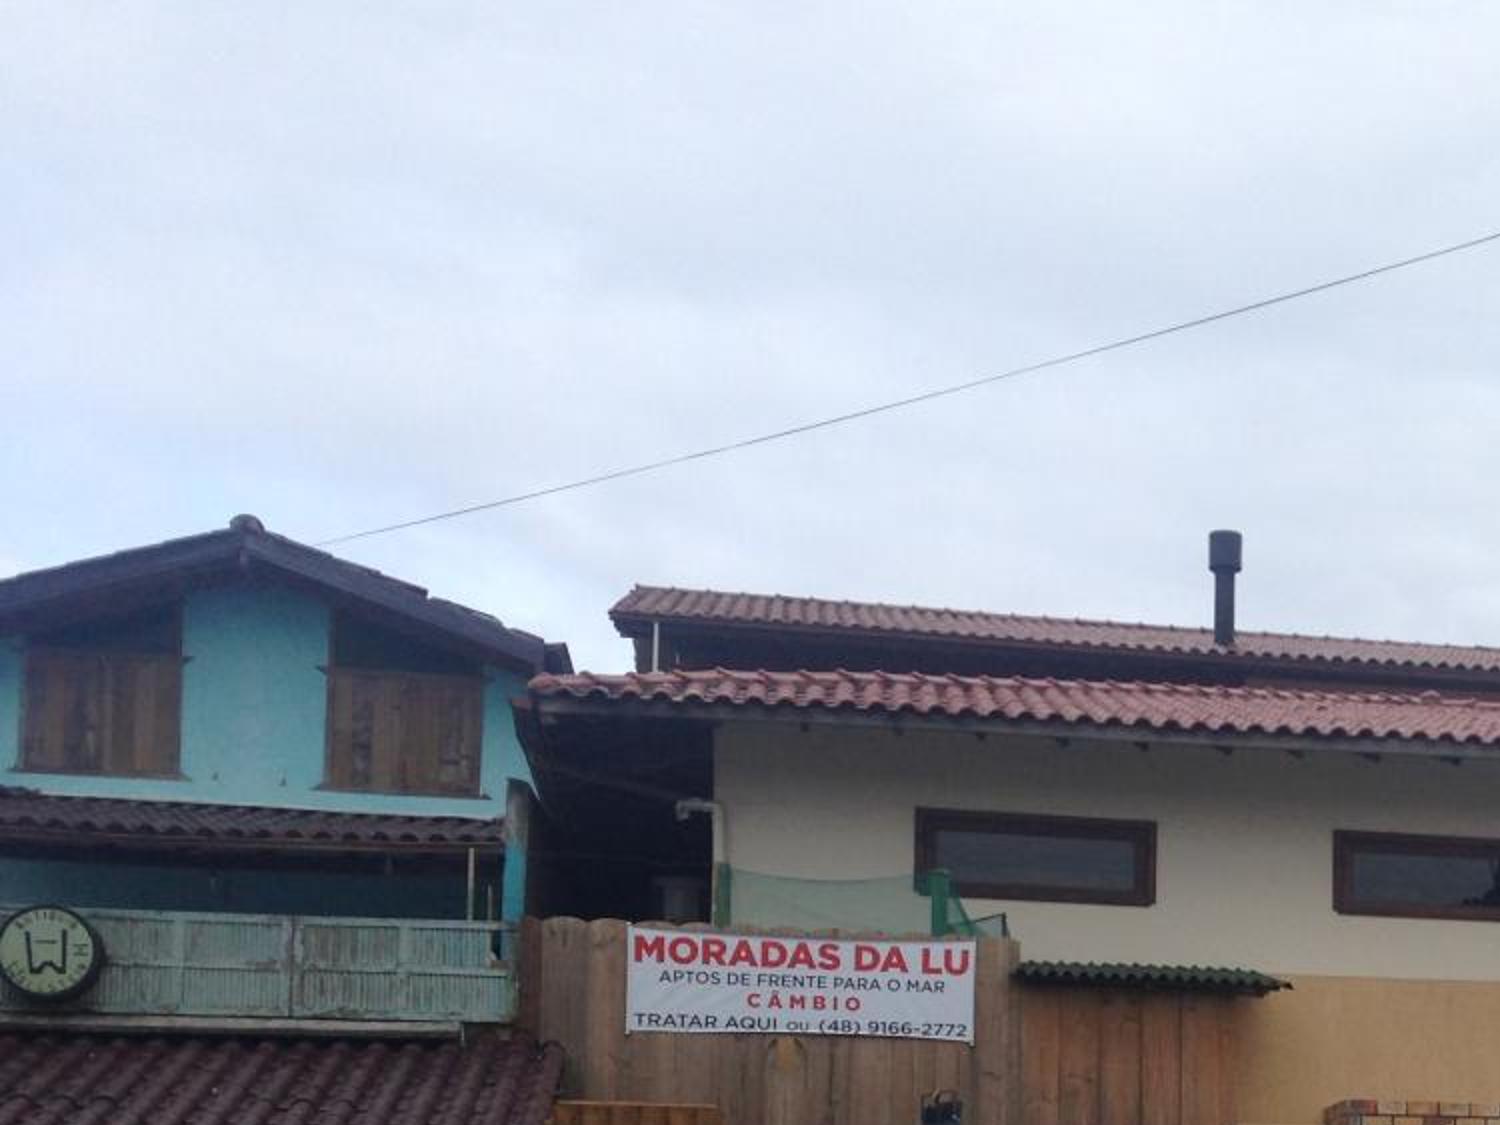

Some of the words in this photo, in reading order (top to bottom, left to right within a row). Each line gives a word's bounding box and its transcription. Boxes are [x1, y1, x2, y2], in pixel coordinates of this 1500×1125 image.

[634, 935, 841, 972] MORADAS
[854, 944, 909, 973] DA
[921, 947, 970, 976] LU
[659, 970, 722, 986] APTOS
[727, 972, 751, 987] DE
[757, 973, 828, 990] FRENTE
[833, 976, 881, 992] PARA
[887, 979, 900, 993] O
[906, 979, 946, 994] MAR
[635, 1013, 718, 1030] TRATAR
[725, 1015, 778, 1032] AQUI
[818, 1018, 861, 1034] (48)
[867, 1020, 967, 1037] 9166-2772
